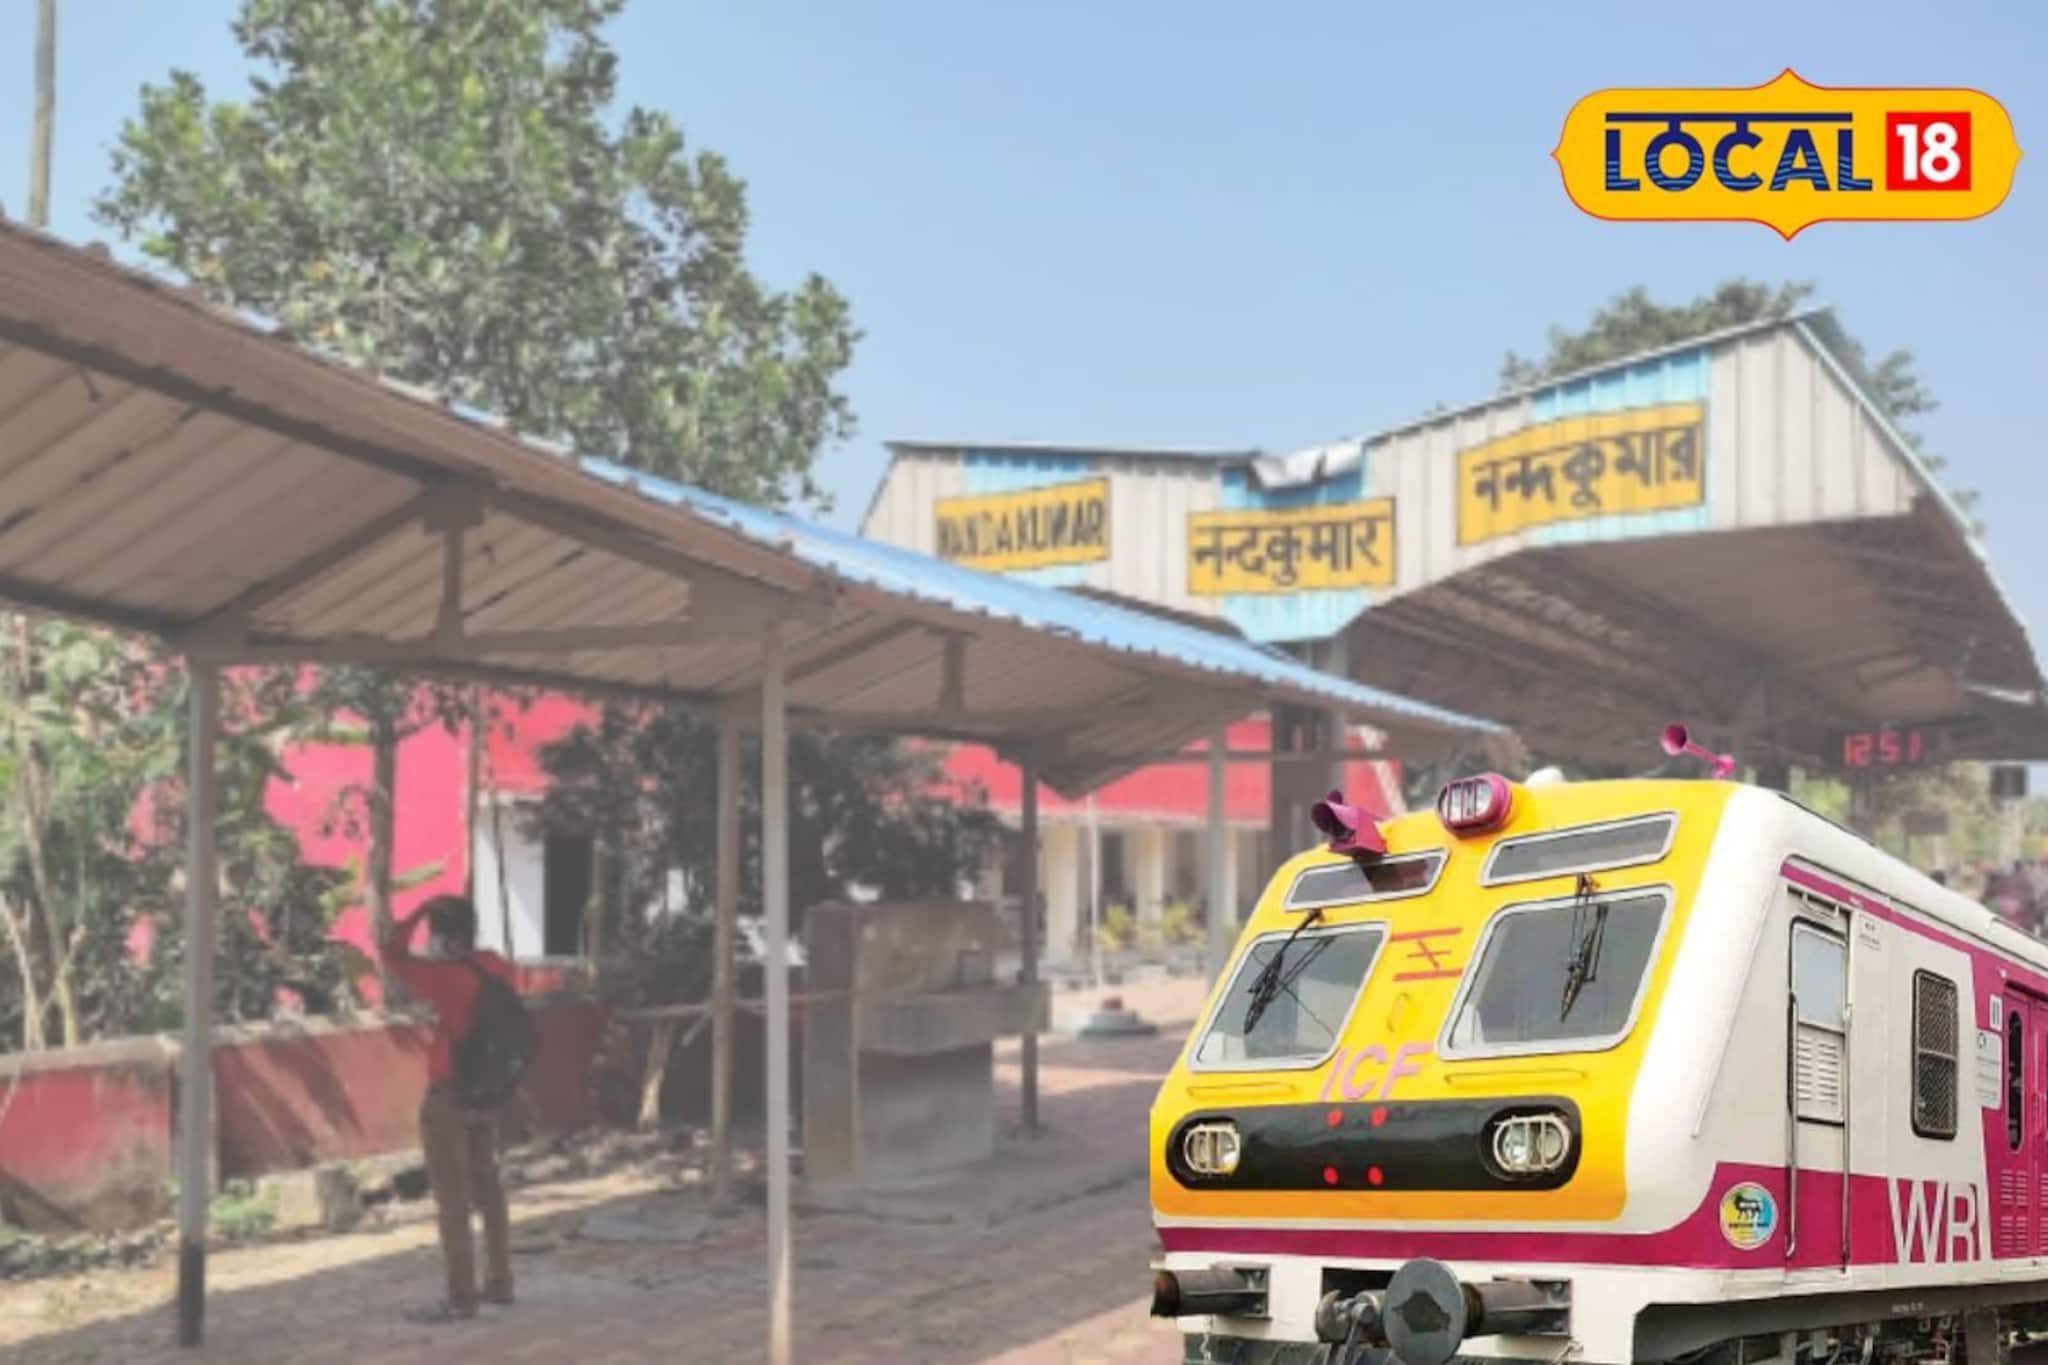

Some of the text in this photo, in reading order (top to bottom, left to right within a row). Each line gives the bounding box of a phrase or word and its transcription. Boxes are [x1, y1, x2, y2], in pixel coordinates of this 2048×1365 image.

[1472, 421, 1701, 512] নন্দকুমার
[1193, 515, 1390, 586] नन्दकुमार
[1319, 1041, 1433, 1103] ICF
